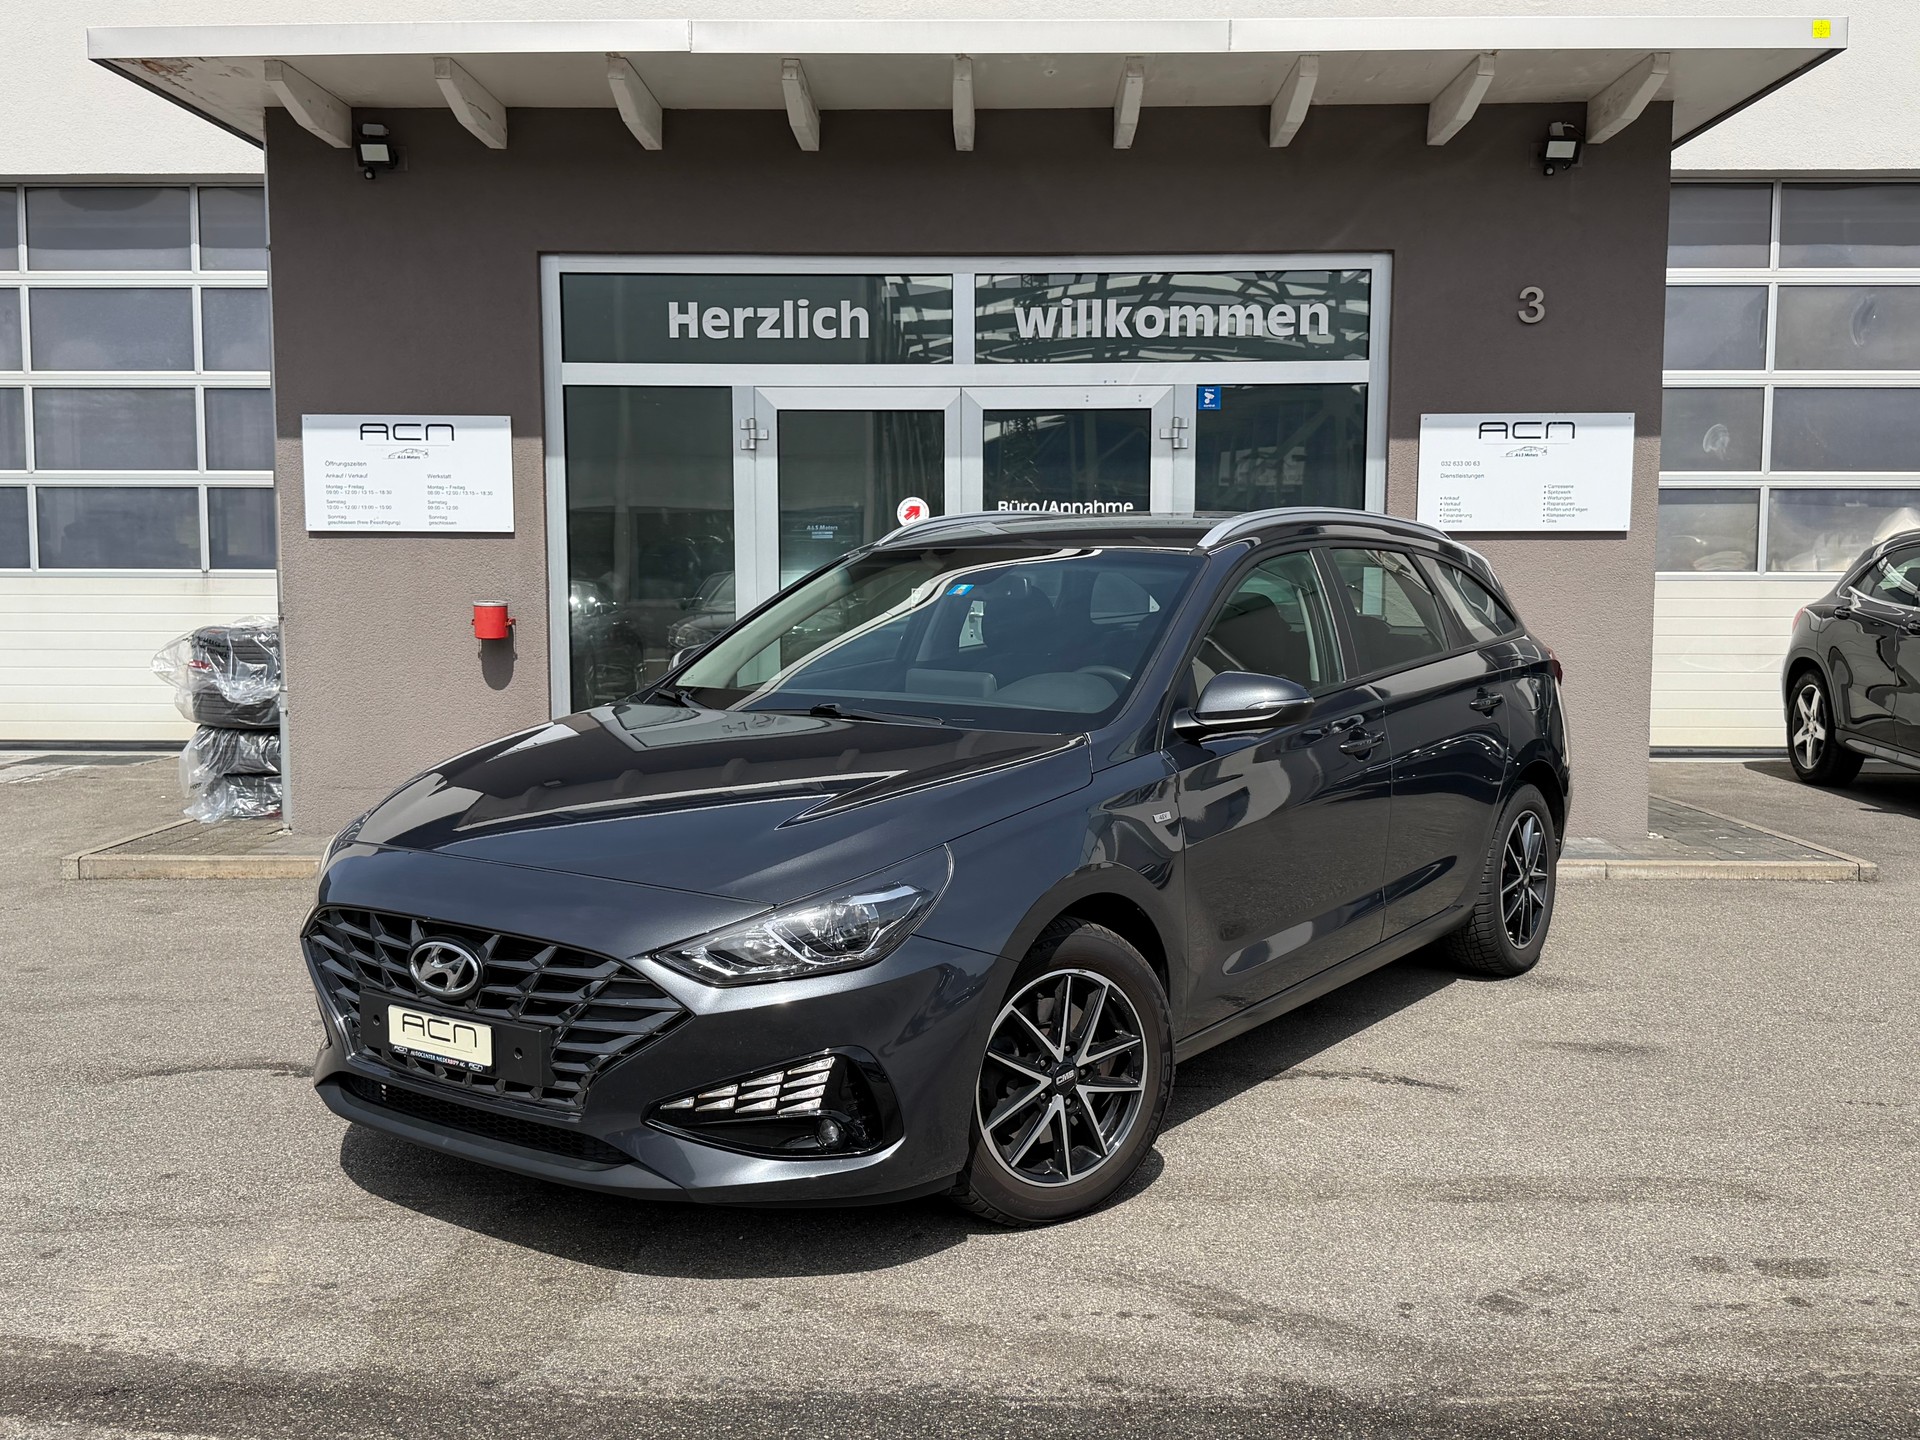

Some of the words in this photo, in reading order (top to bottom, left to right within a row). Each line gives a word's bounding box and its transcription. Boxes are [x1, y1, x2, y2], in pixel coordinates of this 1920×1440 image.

[1518, 286, 1545, 324] 3
[668, 299, 870, 339] Herzlich
[1014, 298, 1329, 338] willkommen
[997, 500, 1134, 514] Büro/Annahme
[410, 1050, 435, 1060] AUTOCENTER
[1056, 1070, 1074, 1085] CMS
